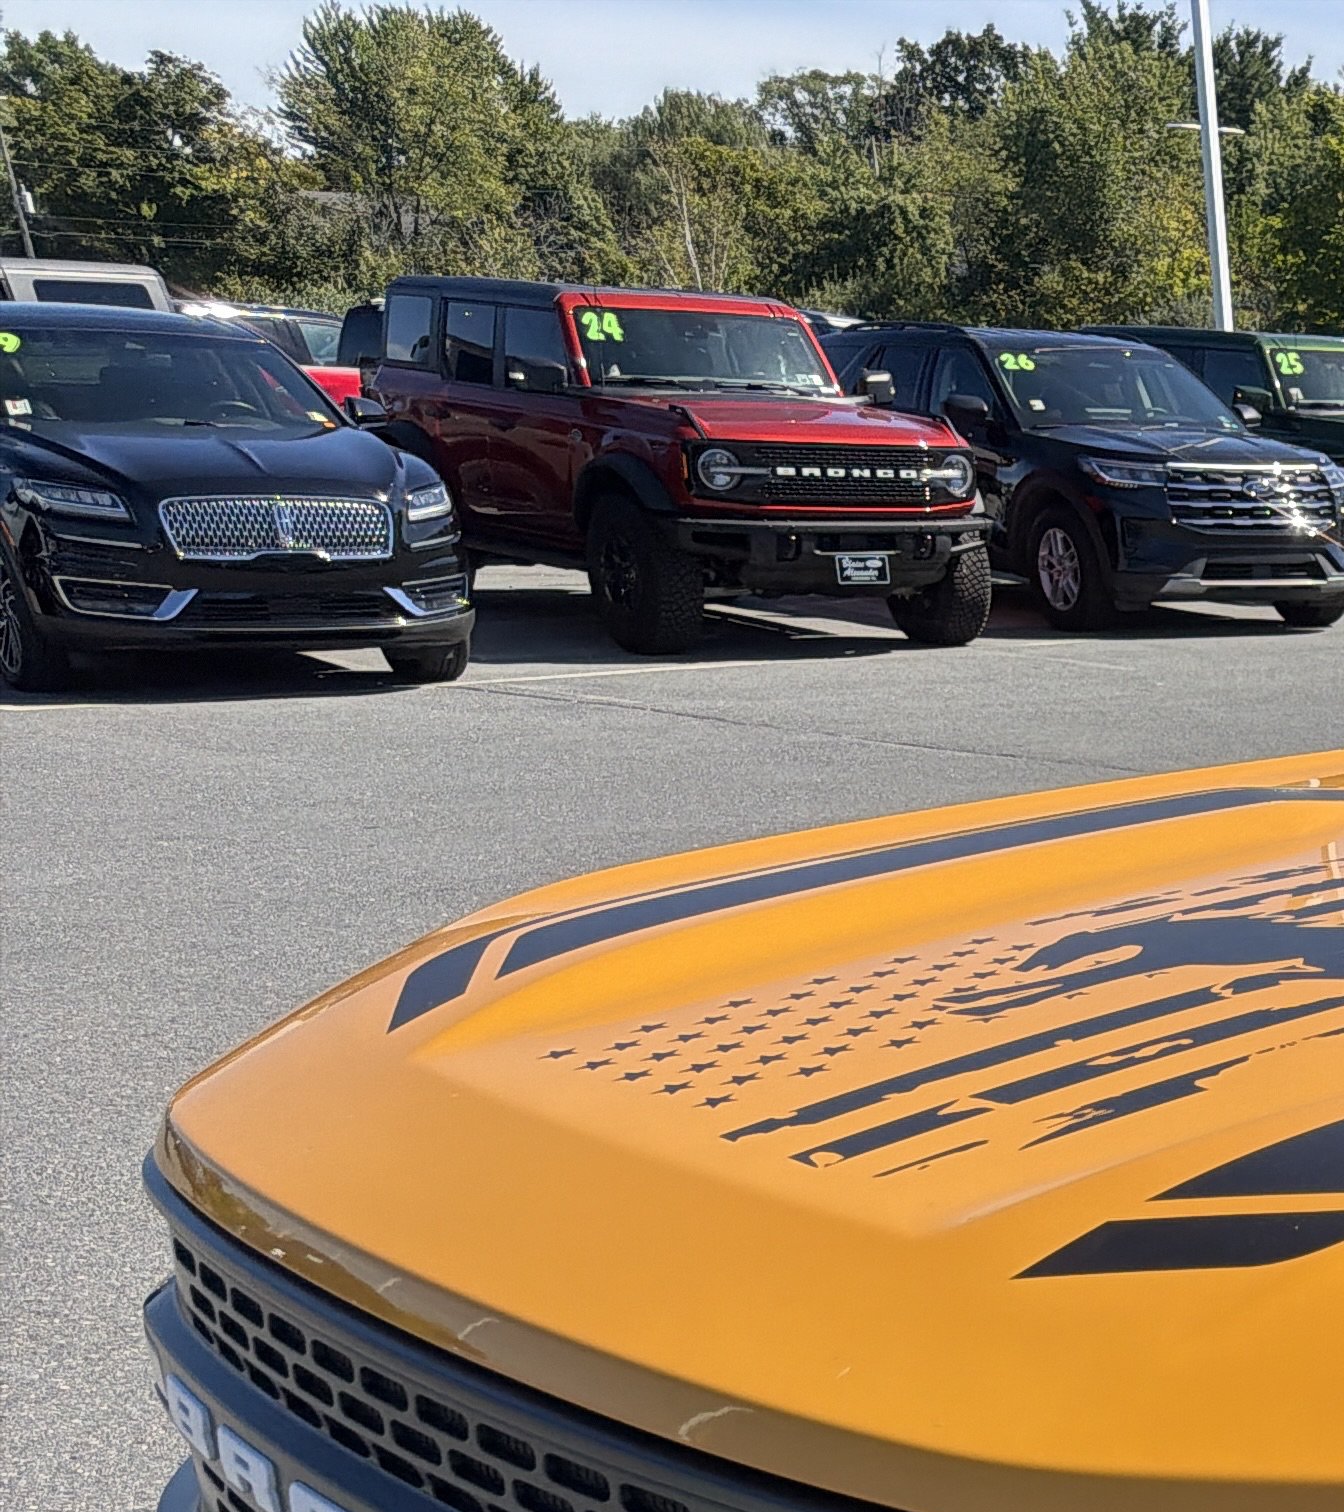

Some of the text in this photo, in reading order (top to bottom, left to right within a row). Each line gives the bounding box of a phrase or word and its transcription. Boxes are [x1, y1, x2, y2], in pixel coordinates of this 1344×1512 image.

[582, 312, 624, 341] 24
[1000, 353, 1035, 370] 26
[1276, 352, 1304, 374] 25
[776, 467, 917, 478] BRONCO
